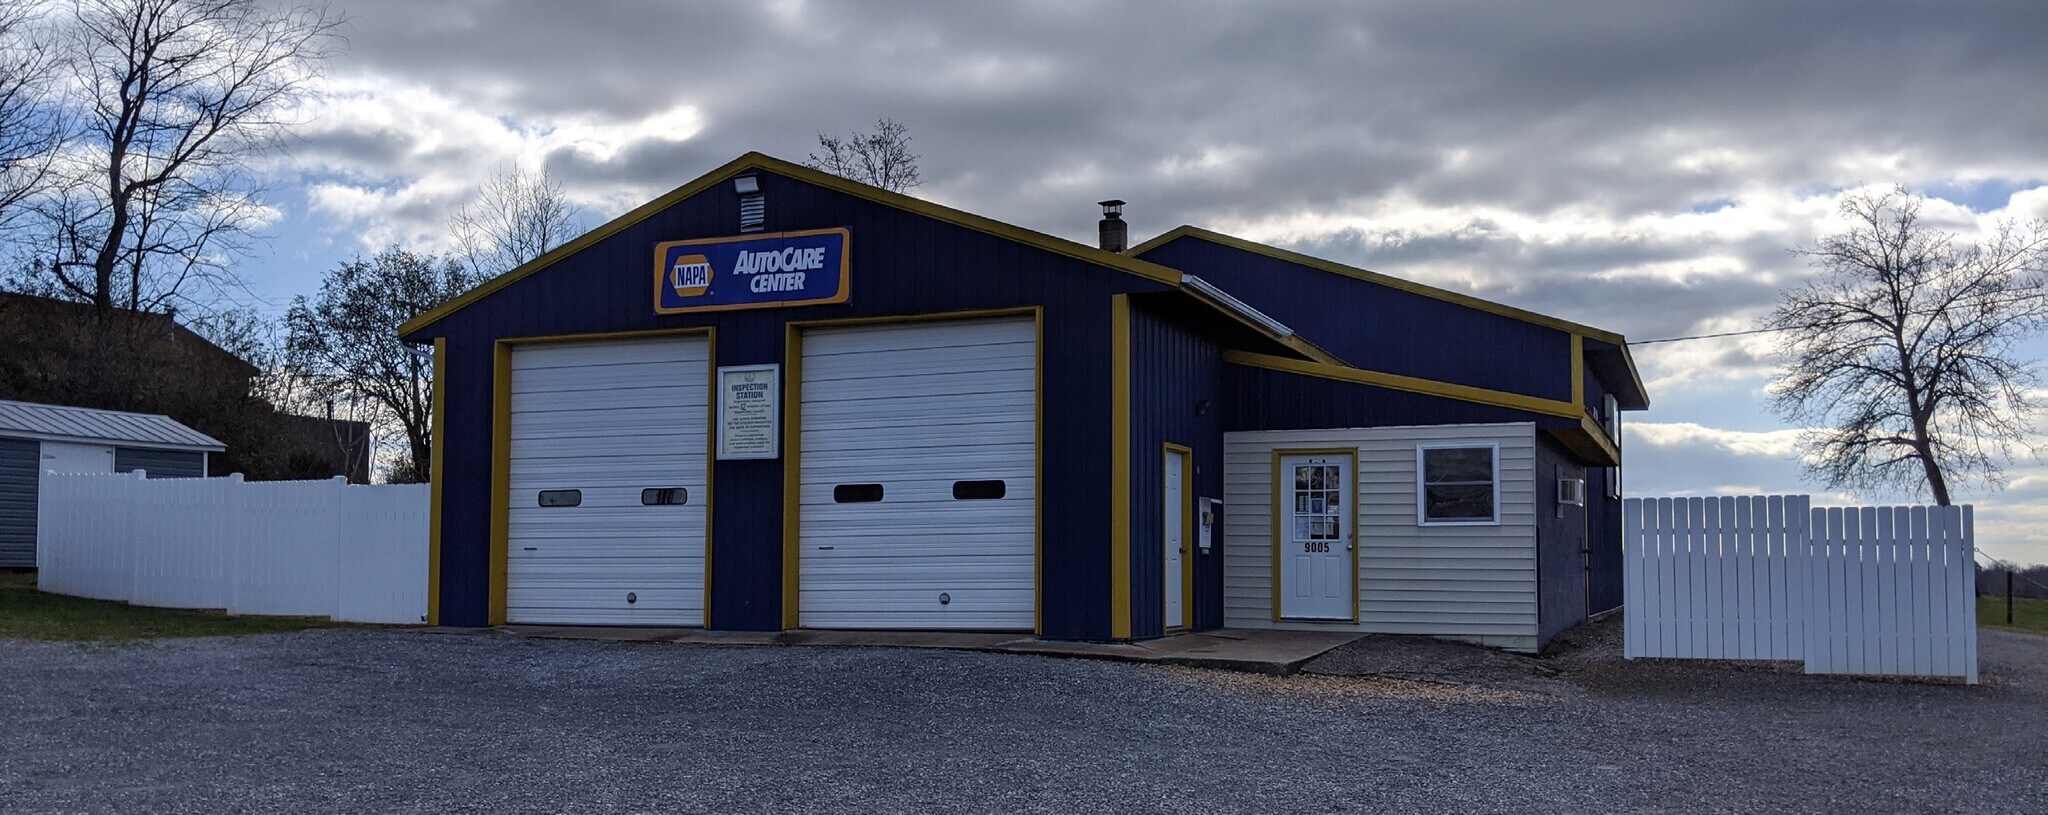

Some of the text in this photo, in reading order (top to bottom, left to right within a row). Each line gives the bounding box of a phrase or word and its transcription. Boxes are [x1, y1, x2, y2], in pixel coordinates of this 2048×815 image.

[733, 247, 825, 275] AUTOCARE
[677, 265, 706, 286] NAPA
[750, 273, 805, 293] CENTER
[732, 383, 768, 392] INSPECTION
[736, 391, 763, 400] STATION
[740, 403, 747, 411] 12
[1304, 542, 1330, 553] 9005
